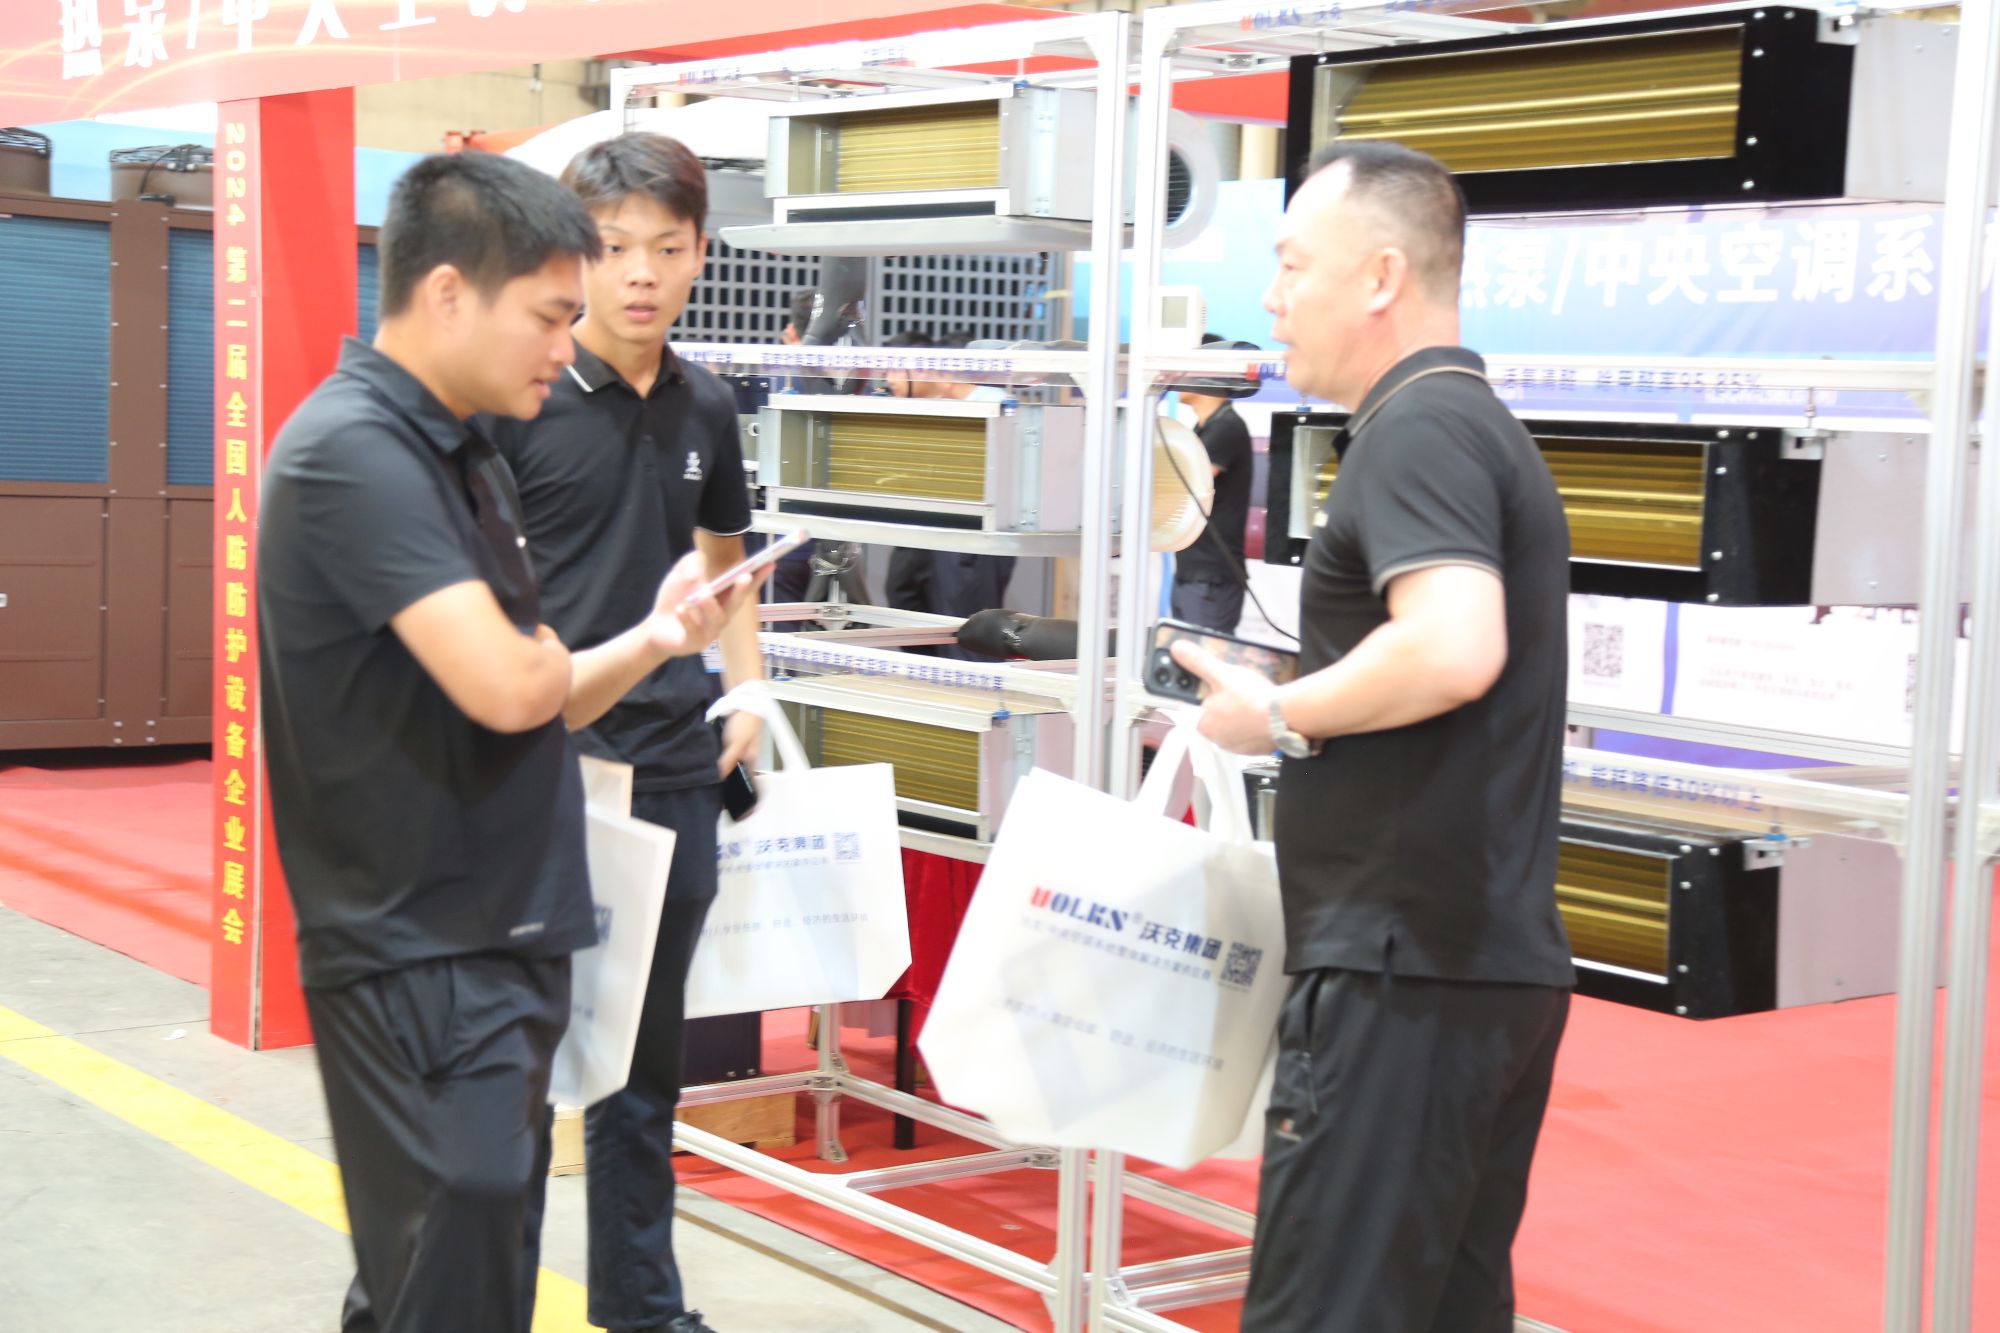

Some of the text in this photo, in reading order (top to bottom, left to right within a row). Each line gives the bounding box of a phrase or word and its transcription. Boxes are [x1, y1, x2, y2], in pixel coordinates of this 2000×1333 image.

[1460, 212, 2000, 316] 泵/中央空调系
[221, 246, 248, 944] 第二届全国人防防护设备企业展会
[1139, 921, 1223, 961] 沃克集团
